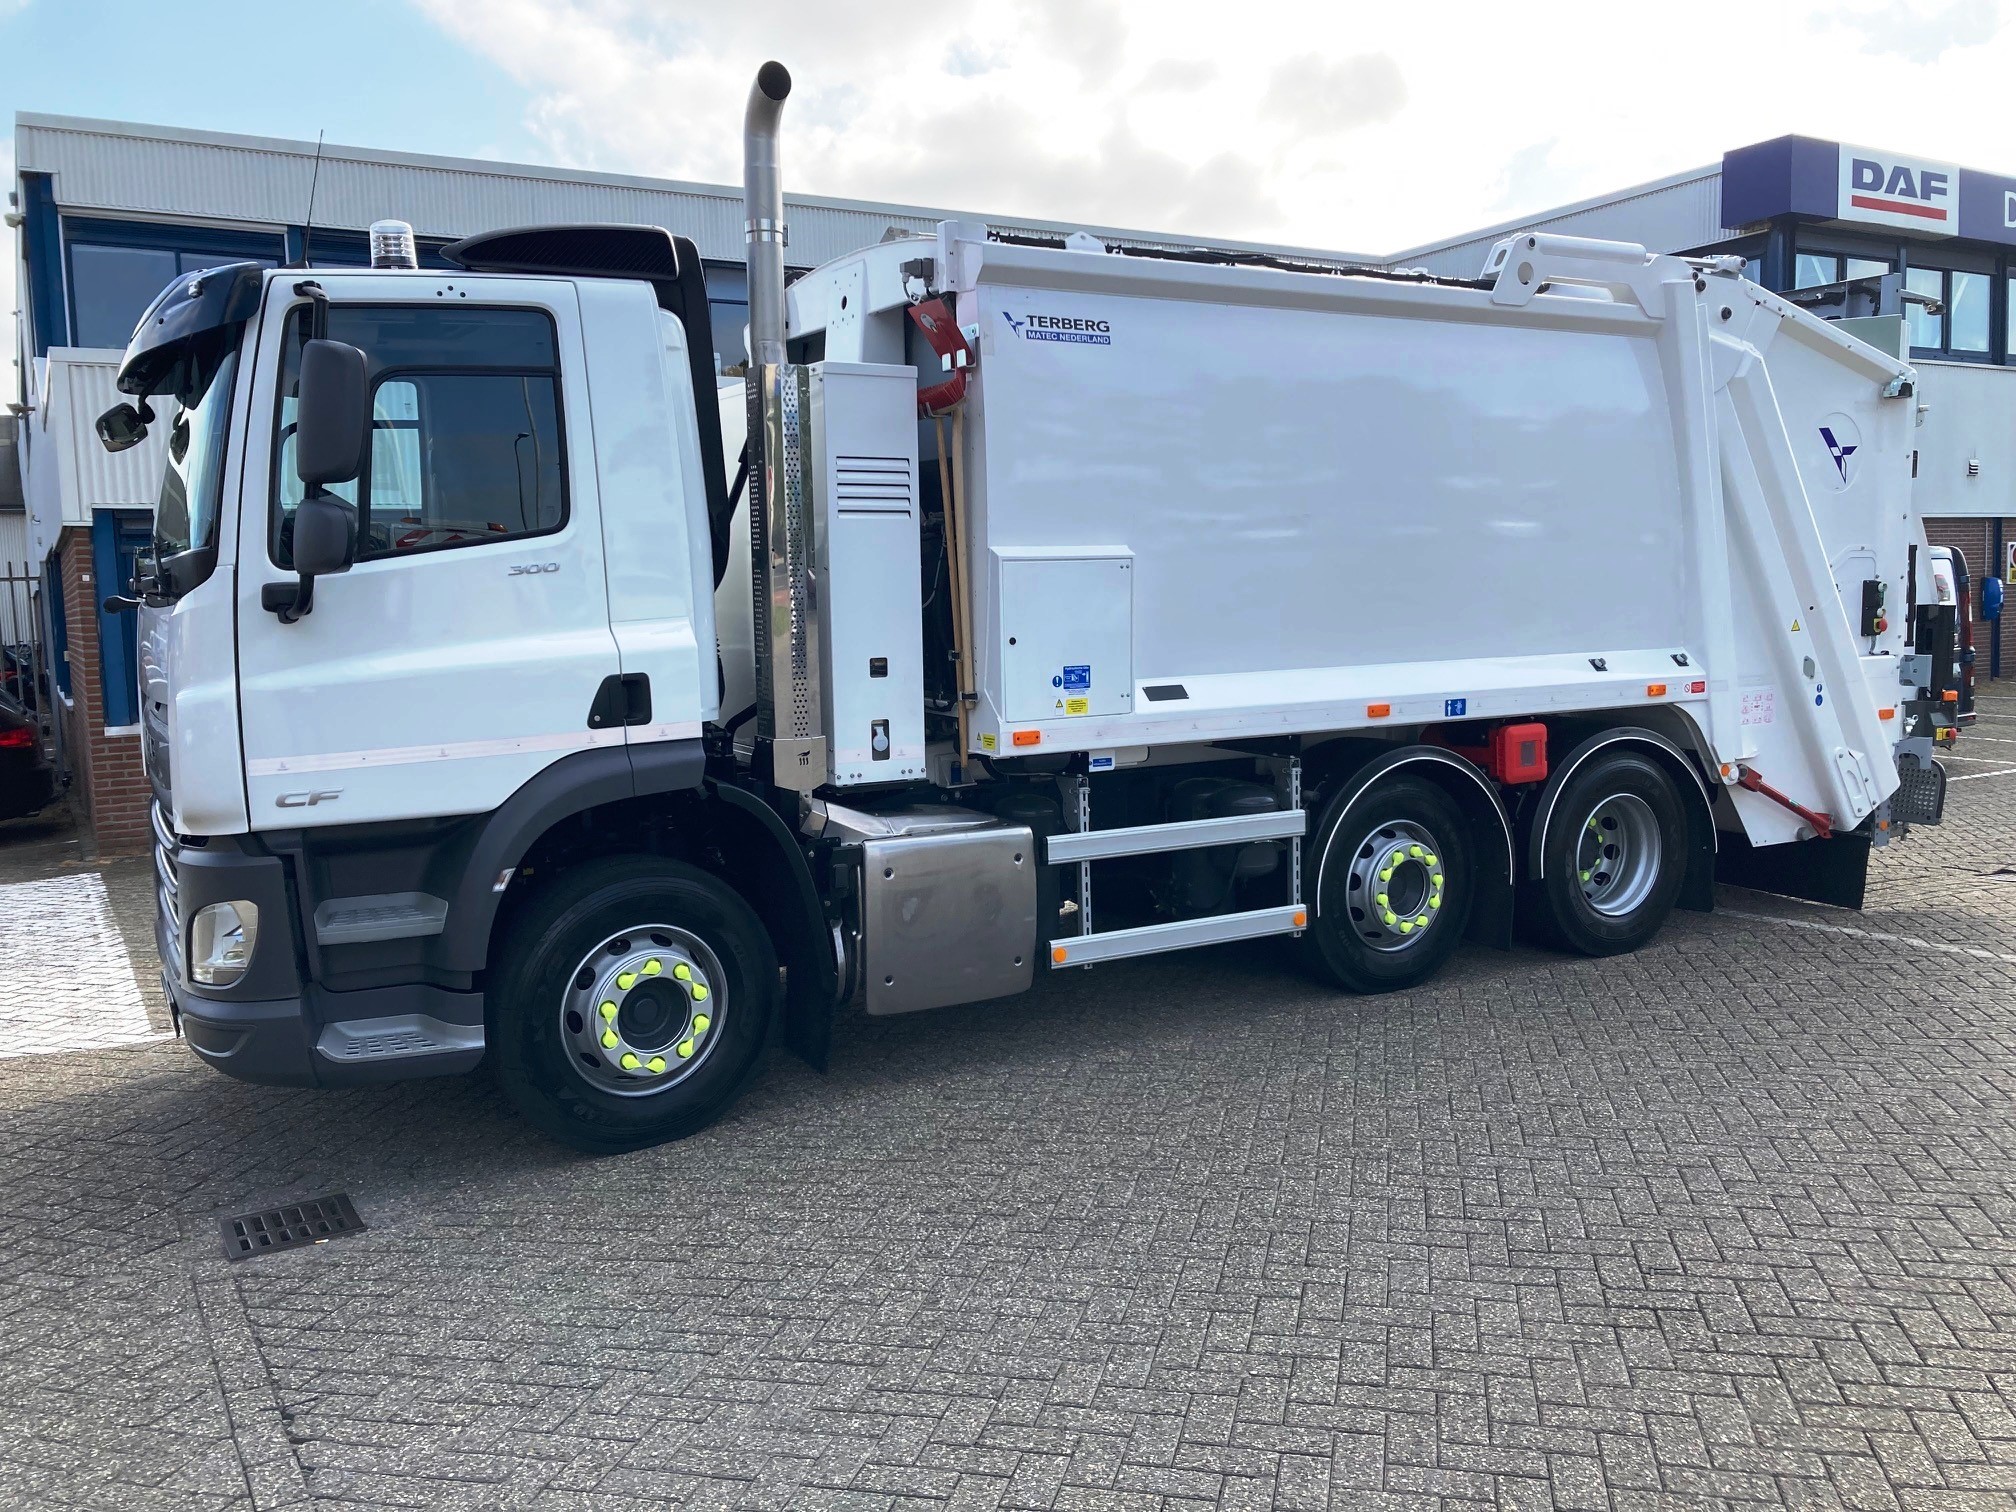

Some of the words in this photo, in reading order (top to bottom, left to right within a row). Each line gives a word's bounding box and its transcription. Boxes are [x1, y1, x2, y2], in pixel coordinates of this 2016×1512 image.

[1852, 158, 1948, 201] DAF
[1026, 314, 1110, 333] TERBERG
[1028, 331, 1058, 340] MATEC
[1059, 333, 1110, 344] NEDERLAND
[508, 562, 560, 576] 300
[275, 787, 344, 808] CF
